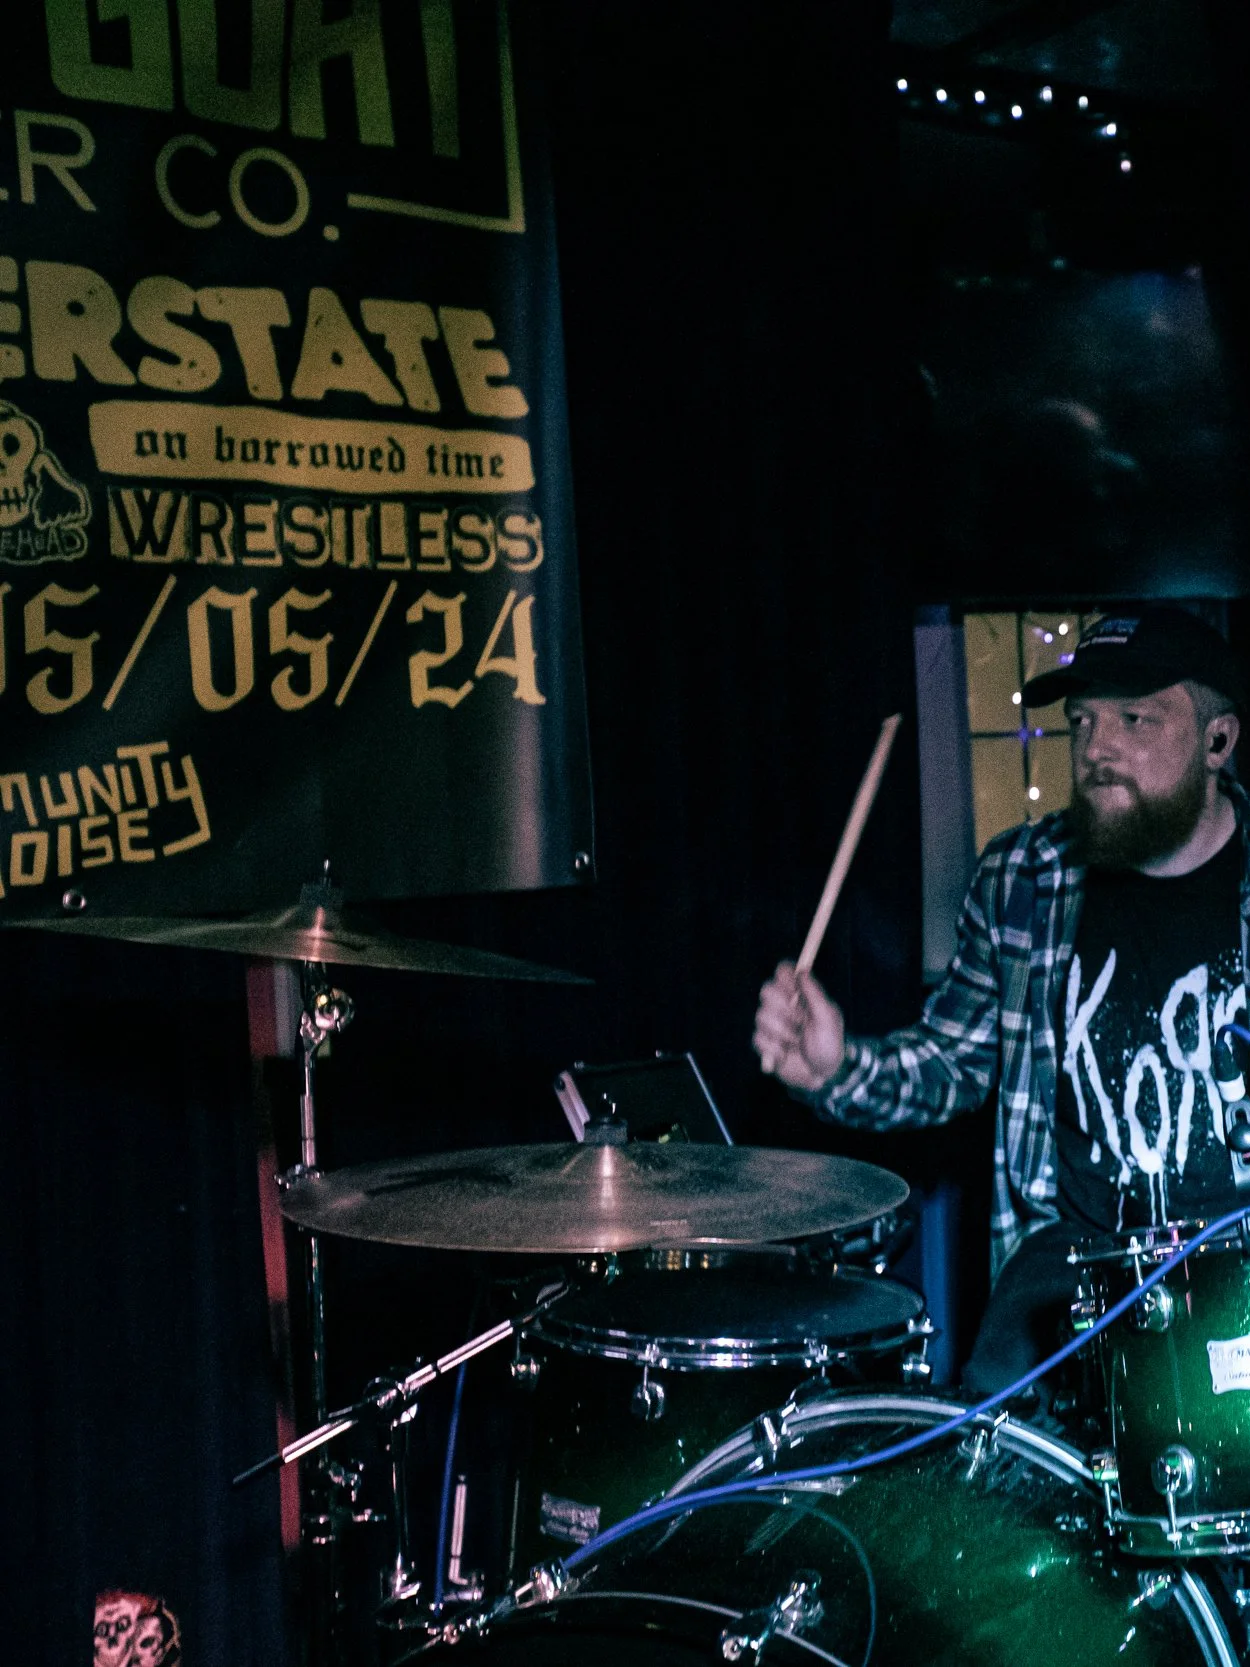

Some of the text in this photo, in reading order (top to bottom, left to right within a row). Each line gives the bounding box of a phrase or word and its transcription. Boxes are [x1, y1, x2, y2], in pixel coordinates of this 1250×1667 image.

[154, 133, 341, 241] CO.
[135, 425, 506, 479] on borrowed time
[107, 485, 545, 574] WRESTLESS
[0, 573, 547, 716] 5/05/24
[0, 807, 157, 899] OISE
